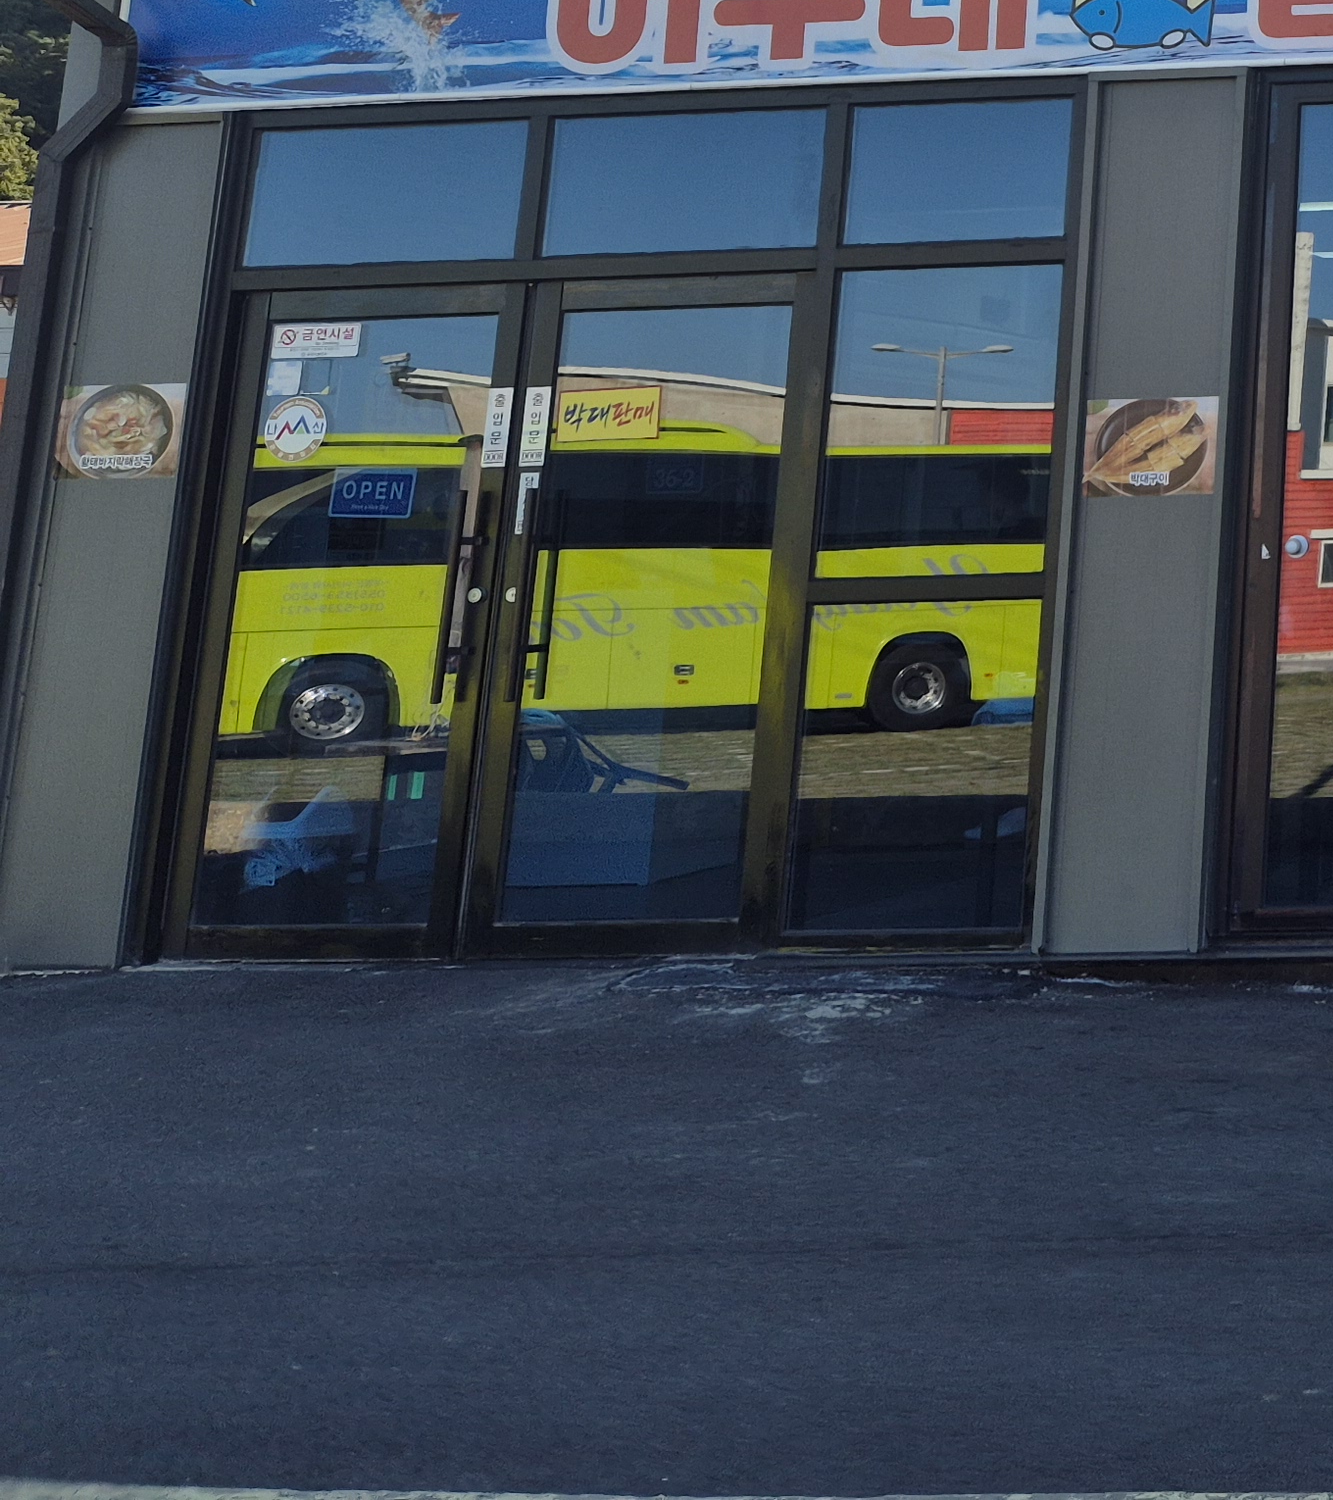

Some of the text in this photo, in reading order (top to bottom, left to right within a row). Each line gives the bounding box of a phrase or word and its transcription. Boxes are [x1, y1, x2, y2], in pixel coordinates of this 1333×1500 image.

[302, 327, 354, 341] 금연시설
[490, 393, 506, 445] 출입문
[528, 392, 544, 445] 출입문
[1130, 473, 1169, 485] 박대구이
[342, 480, 404, 500] OPEN
